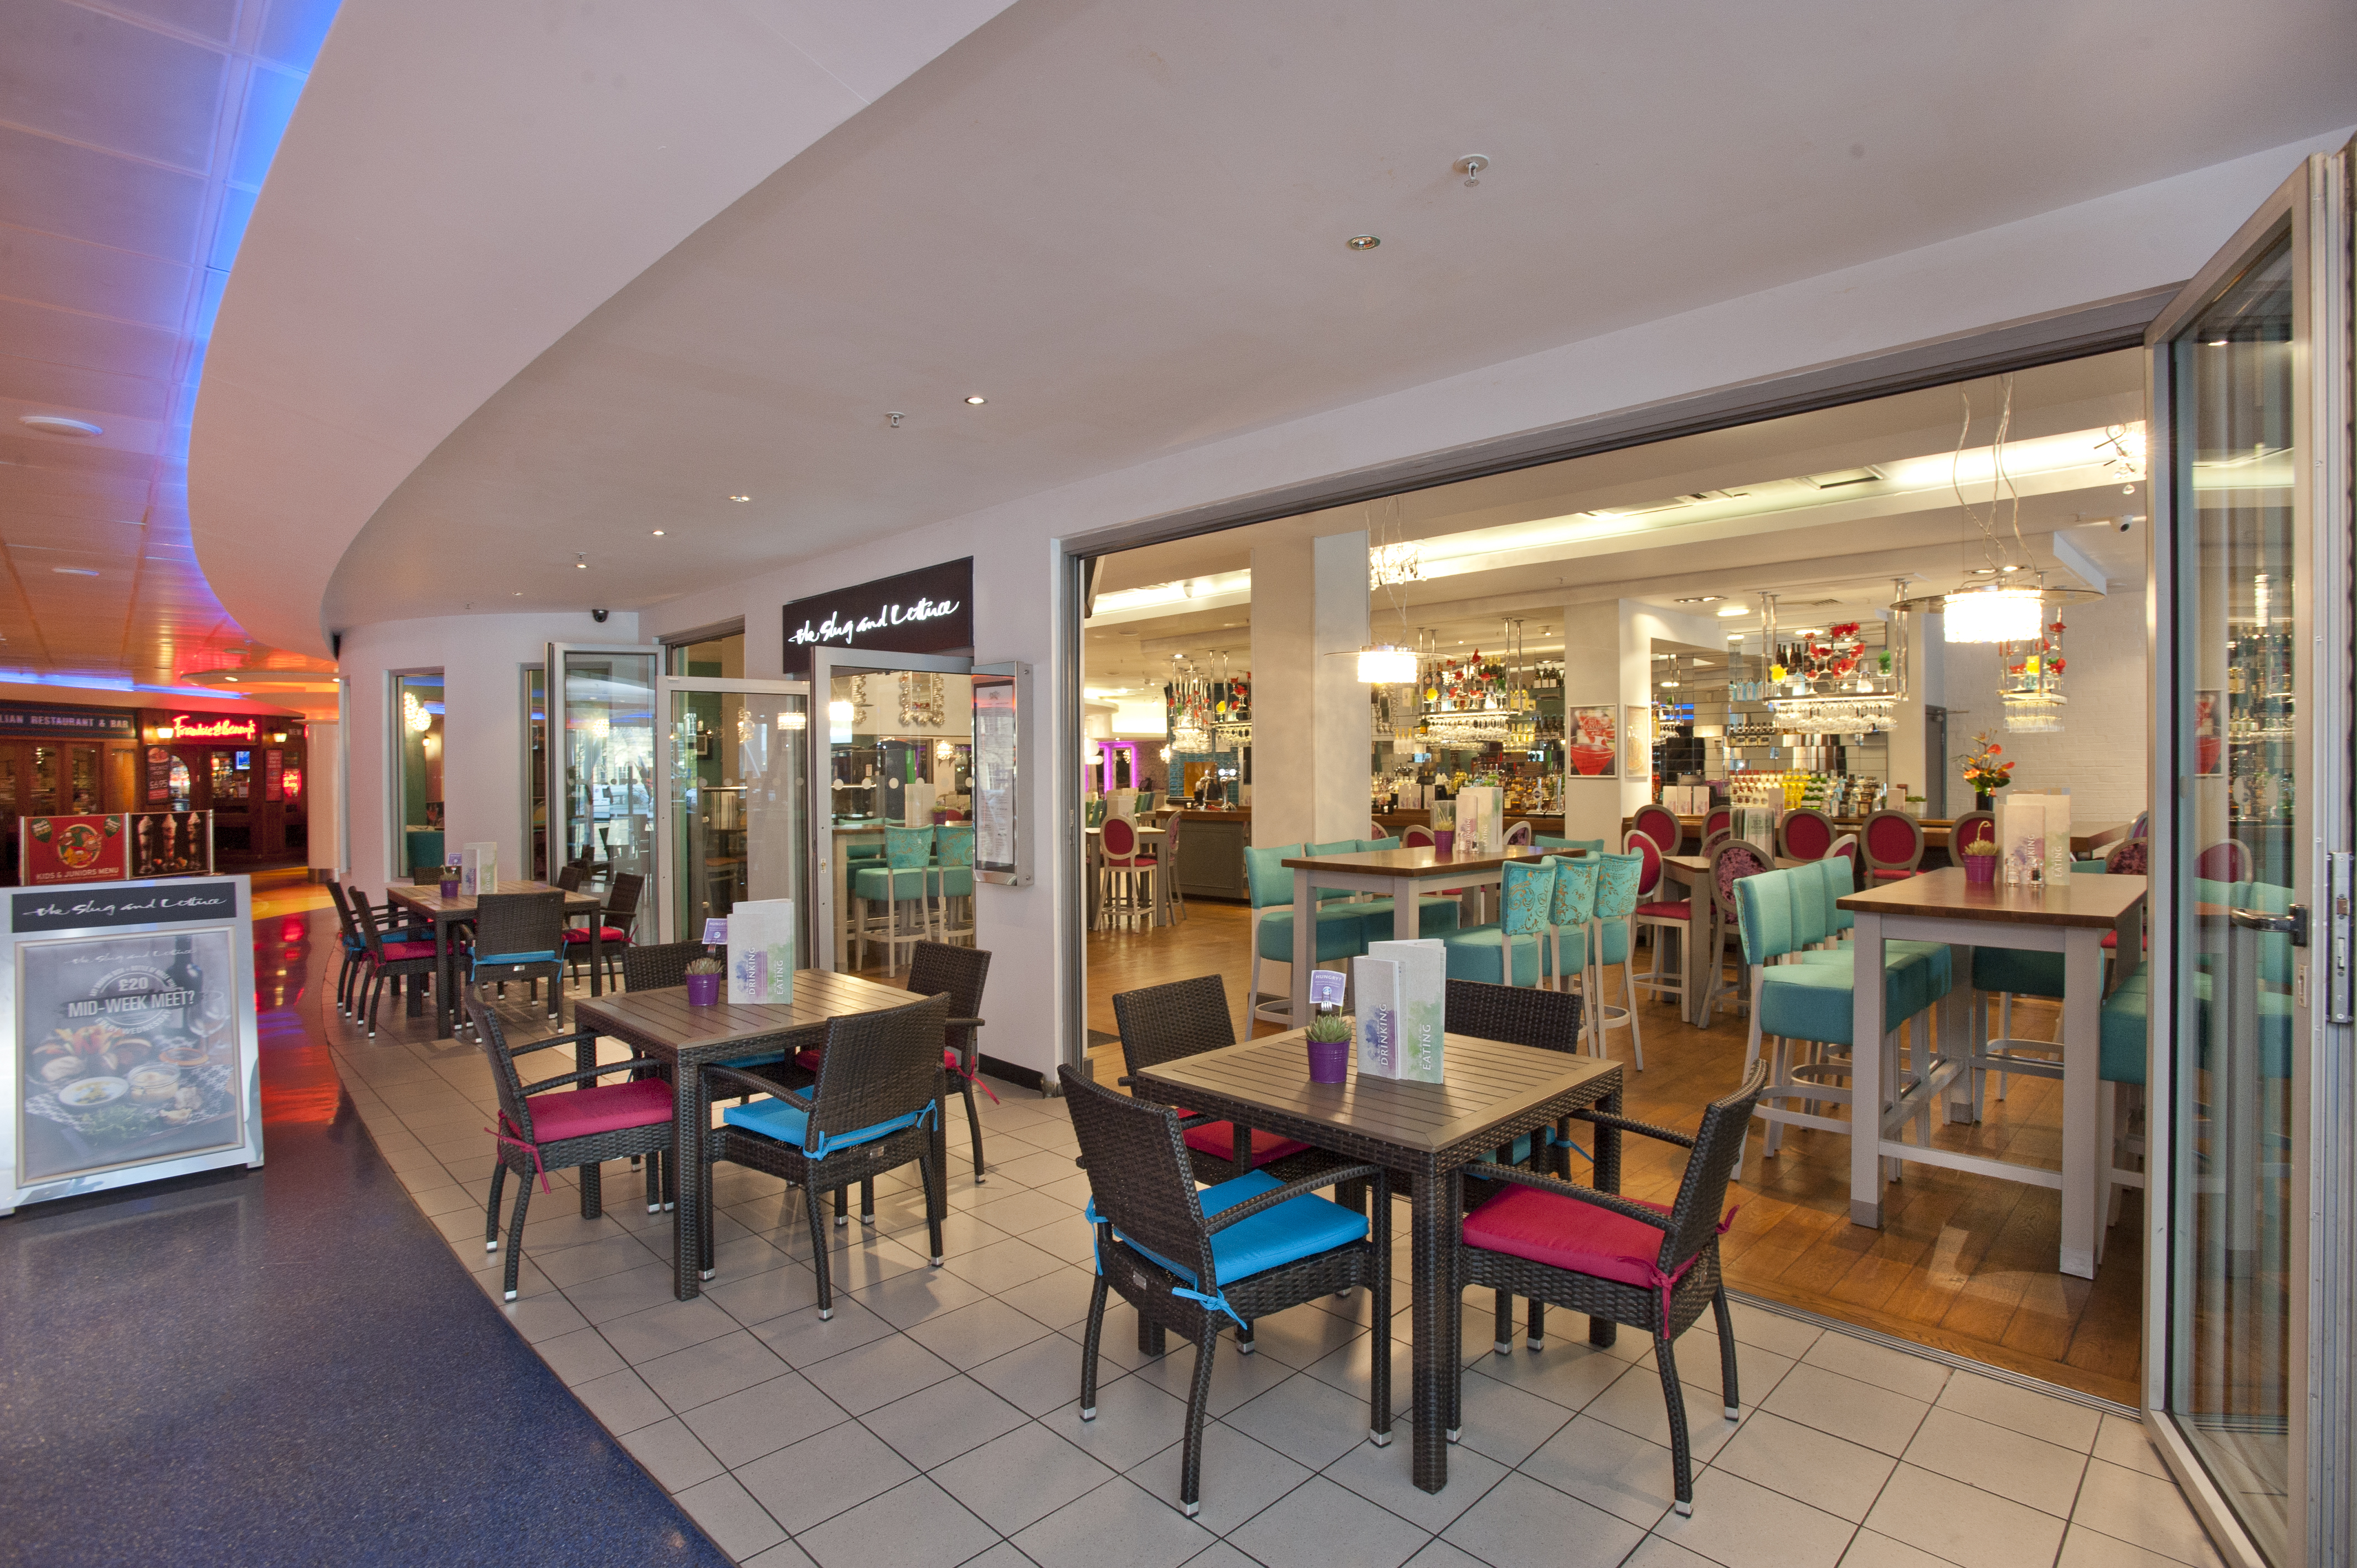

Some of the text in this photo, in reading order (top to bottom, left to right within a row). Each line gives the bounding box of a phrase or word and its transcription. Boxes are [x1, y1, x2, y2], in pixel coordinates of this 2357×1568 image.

[788, 597, 960, 644] the Slug and Lettuce
[30, 716, 94, 726] RESTAURANT
[64, 869, 97, 877] JUNIORS
[23, 897, 228, 916] the Slug and Lettuce
[119, 977, 149, 991] £20
[68, 991, 195, 1018] MID-WEEK MEET?
[1380, 1004, 1388, 1066] DRINKING
[1422, 1024, 1431, 1070] EATING
